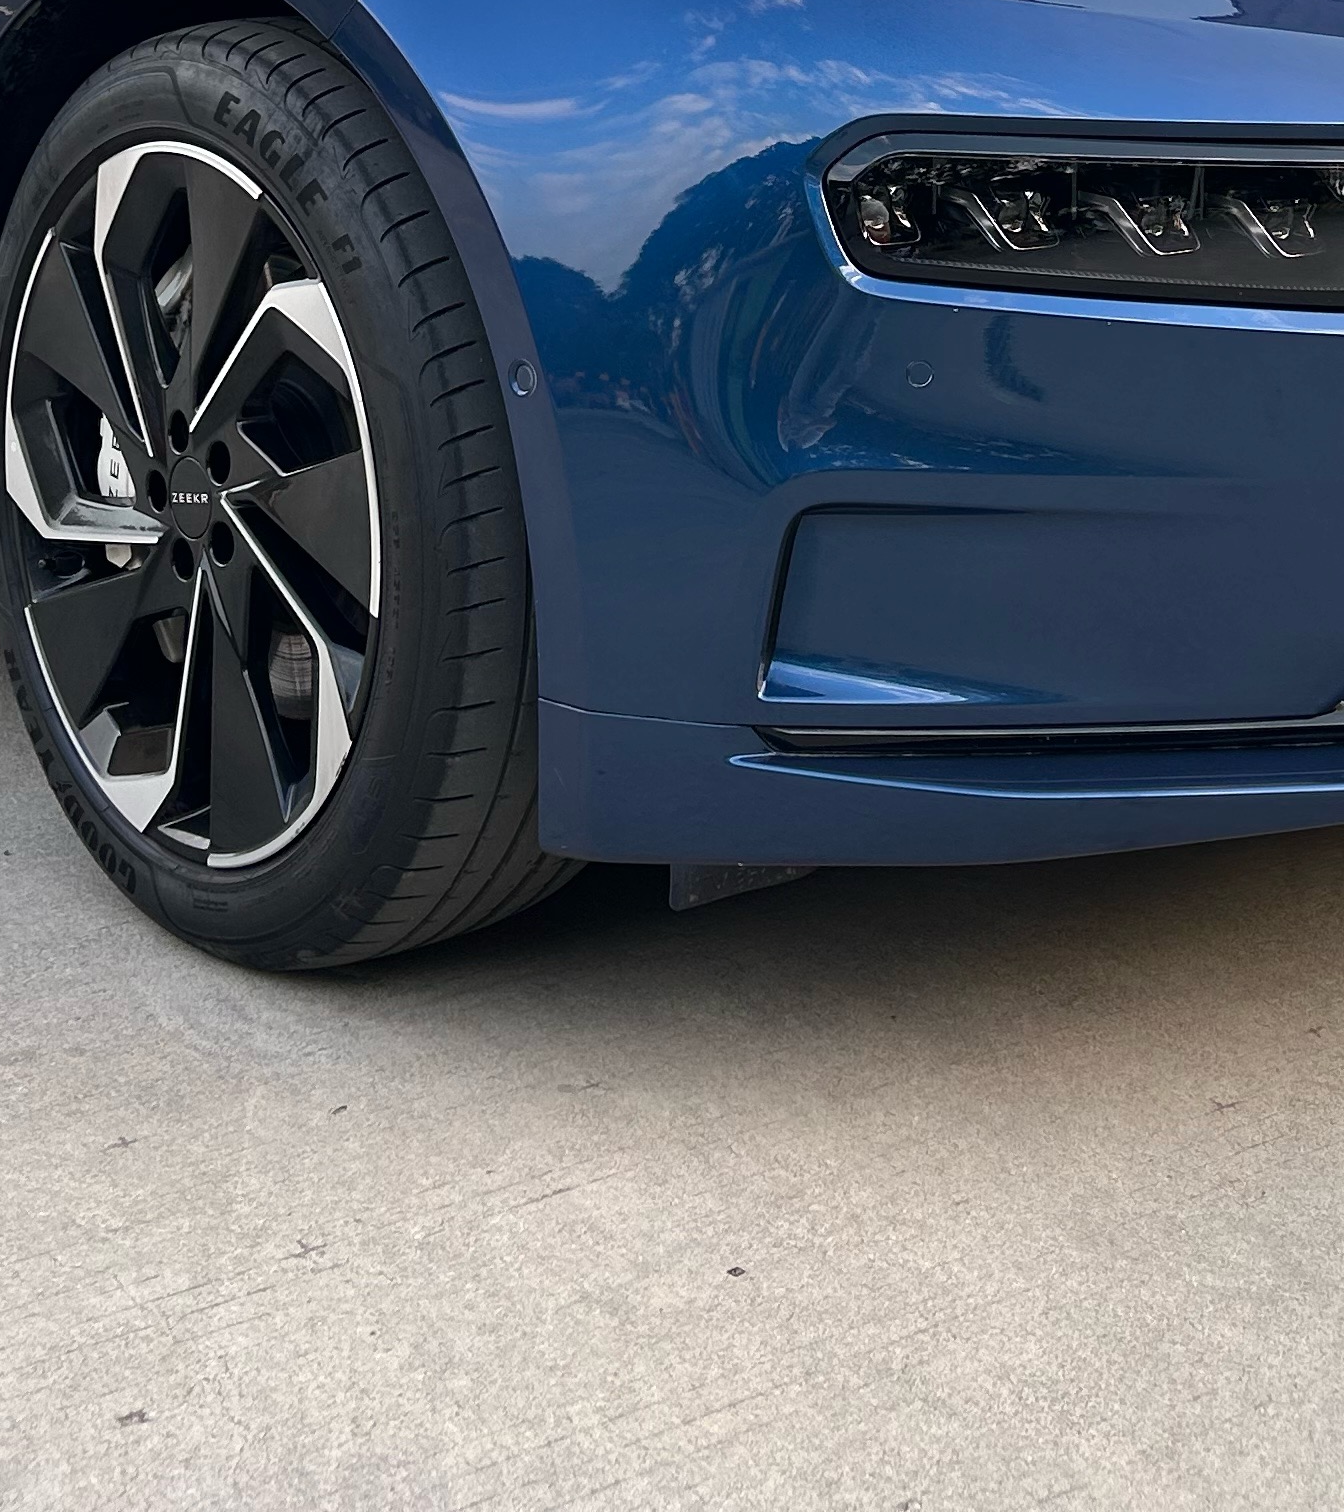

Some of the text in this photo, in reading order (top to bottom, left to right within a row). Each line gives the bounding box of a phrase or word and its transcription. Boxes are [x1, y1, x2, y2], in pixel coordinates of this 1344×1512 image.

[213, 90, 363, 275] EAGLE F1
[171, 492, 209, 504] ZEEKR
